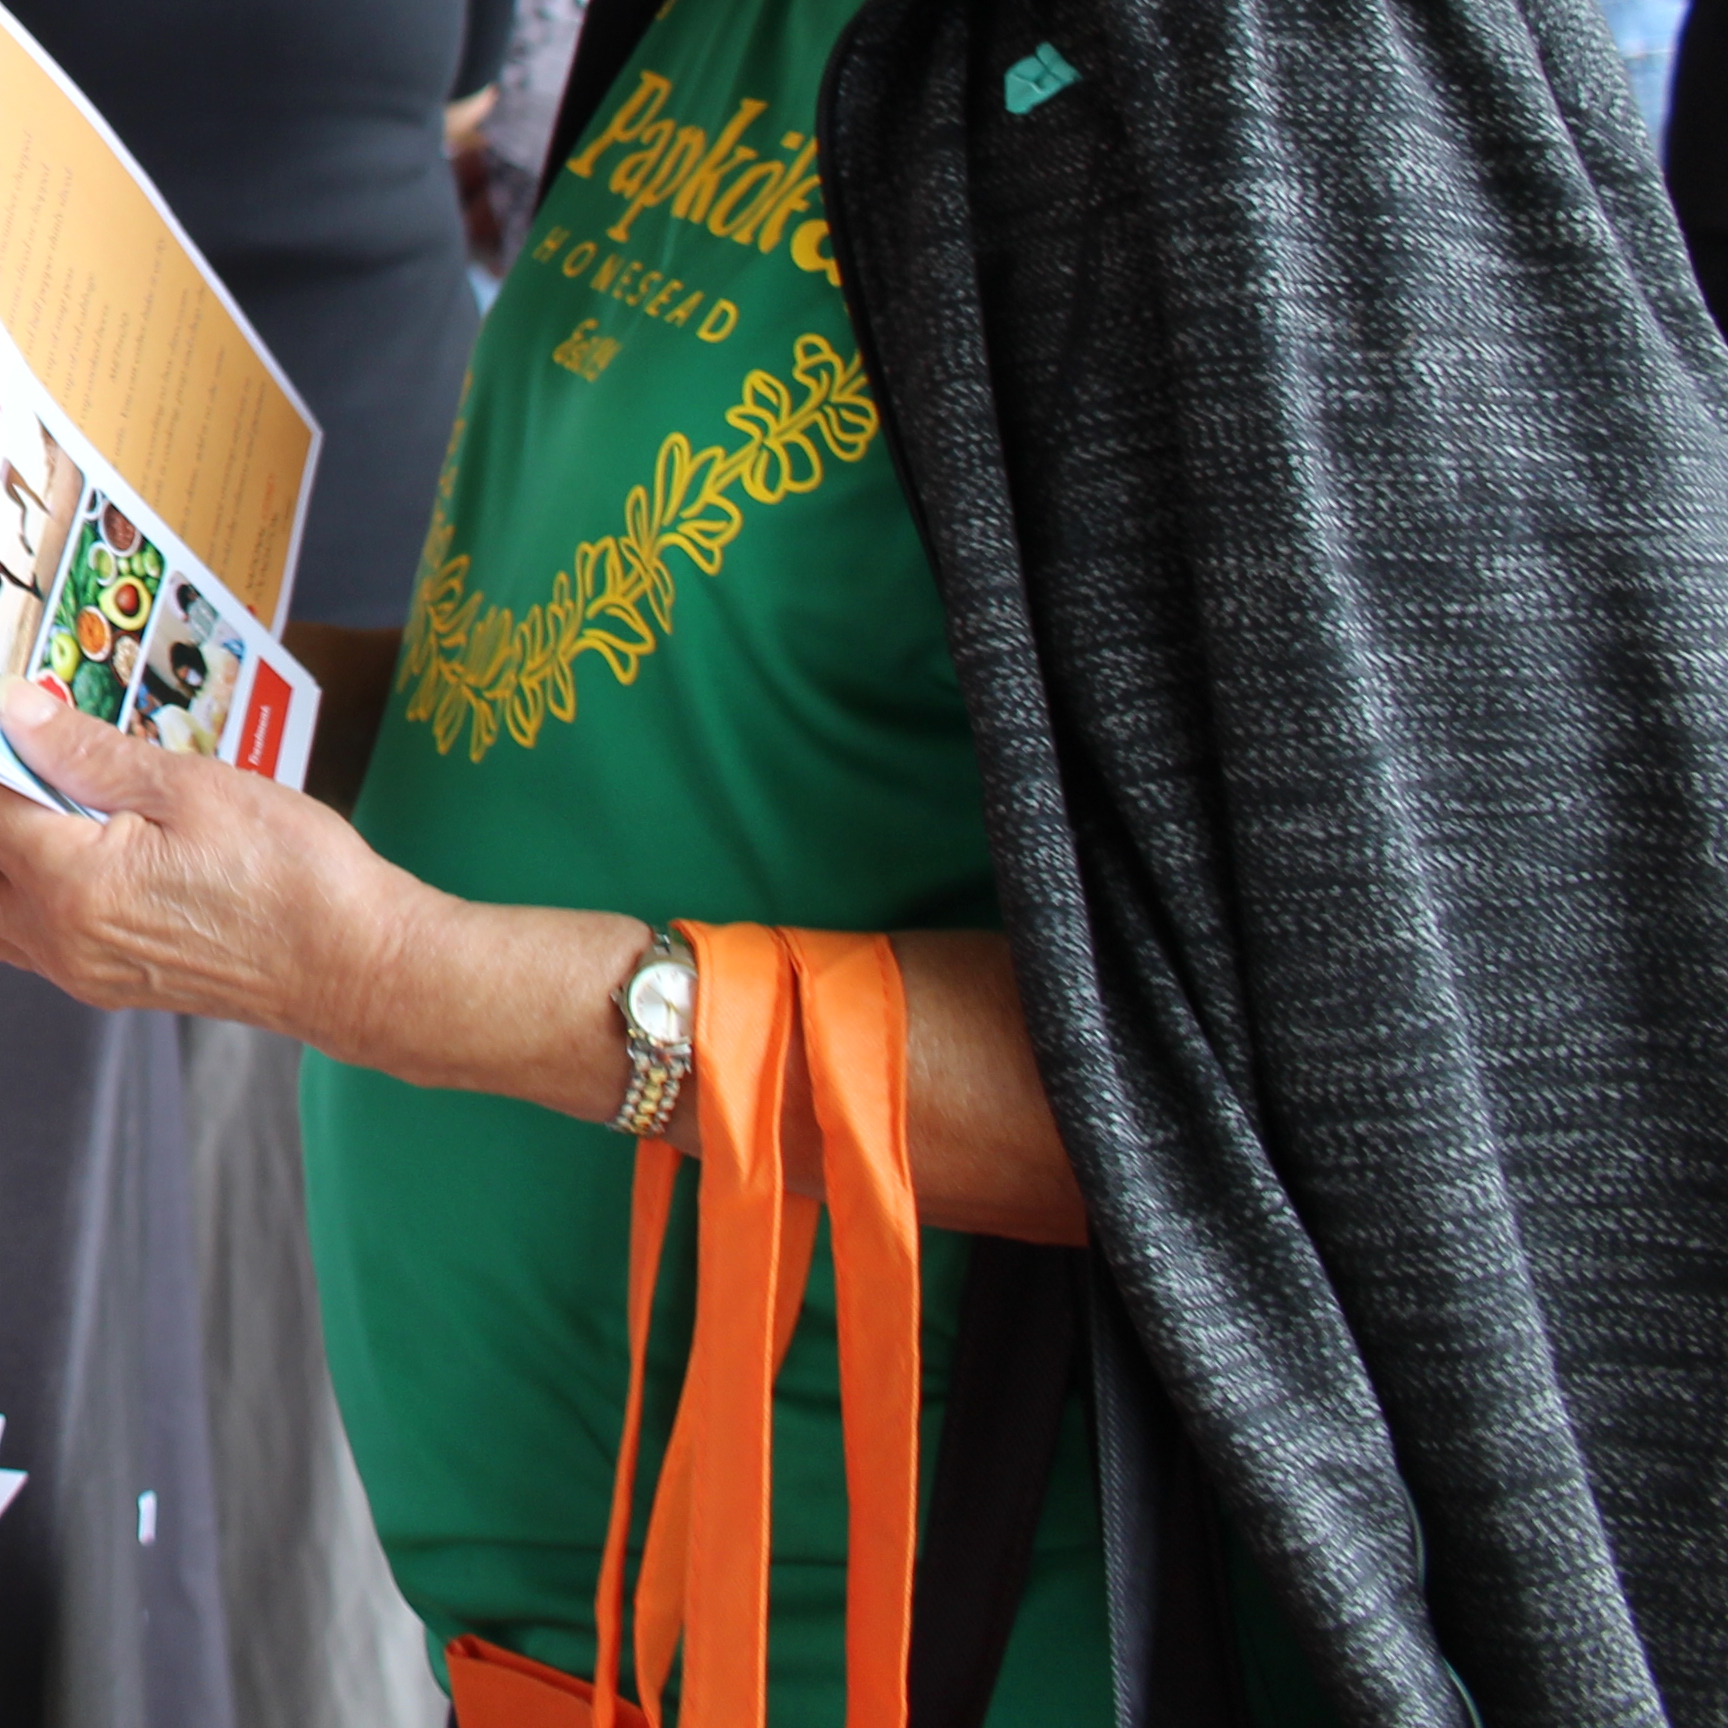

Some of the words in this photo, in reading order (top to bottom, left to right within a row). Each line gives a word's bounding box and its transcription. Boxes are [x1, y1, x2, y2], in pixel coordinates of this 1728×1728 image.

[9, 131, 36, 192] chopped
[26, 162, 53, 222] chopped
[26, 300, 44, 331] bell
[36, 255, 57, 302] pepper
